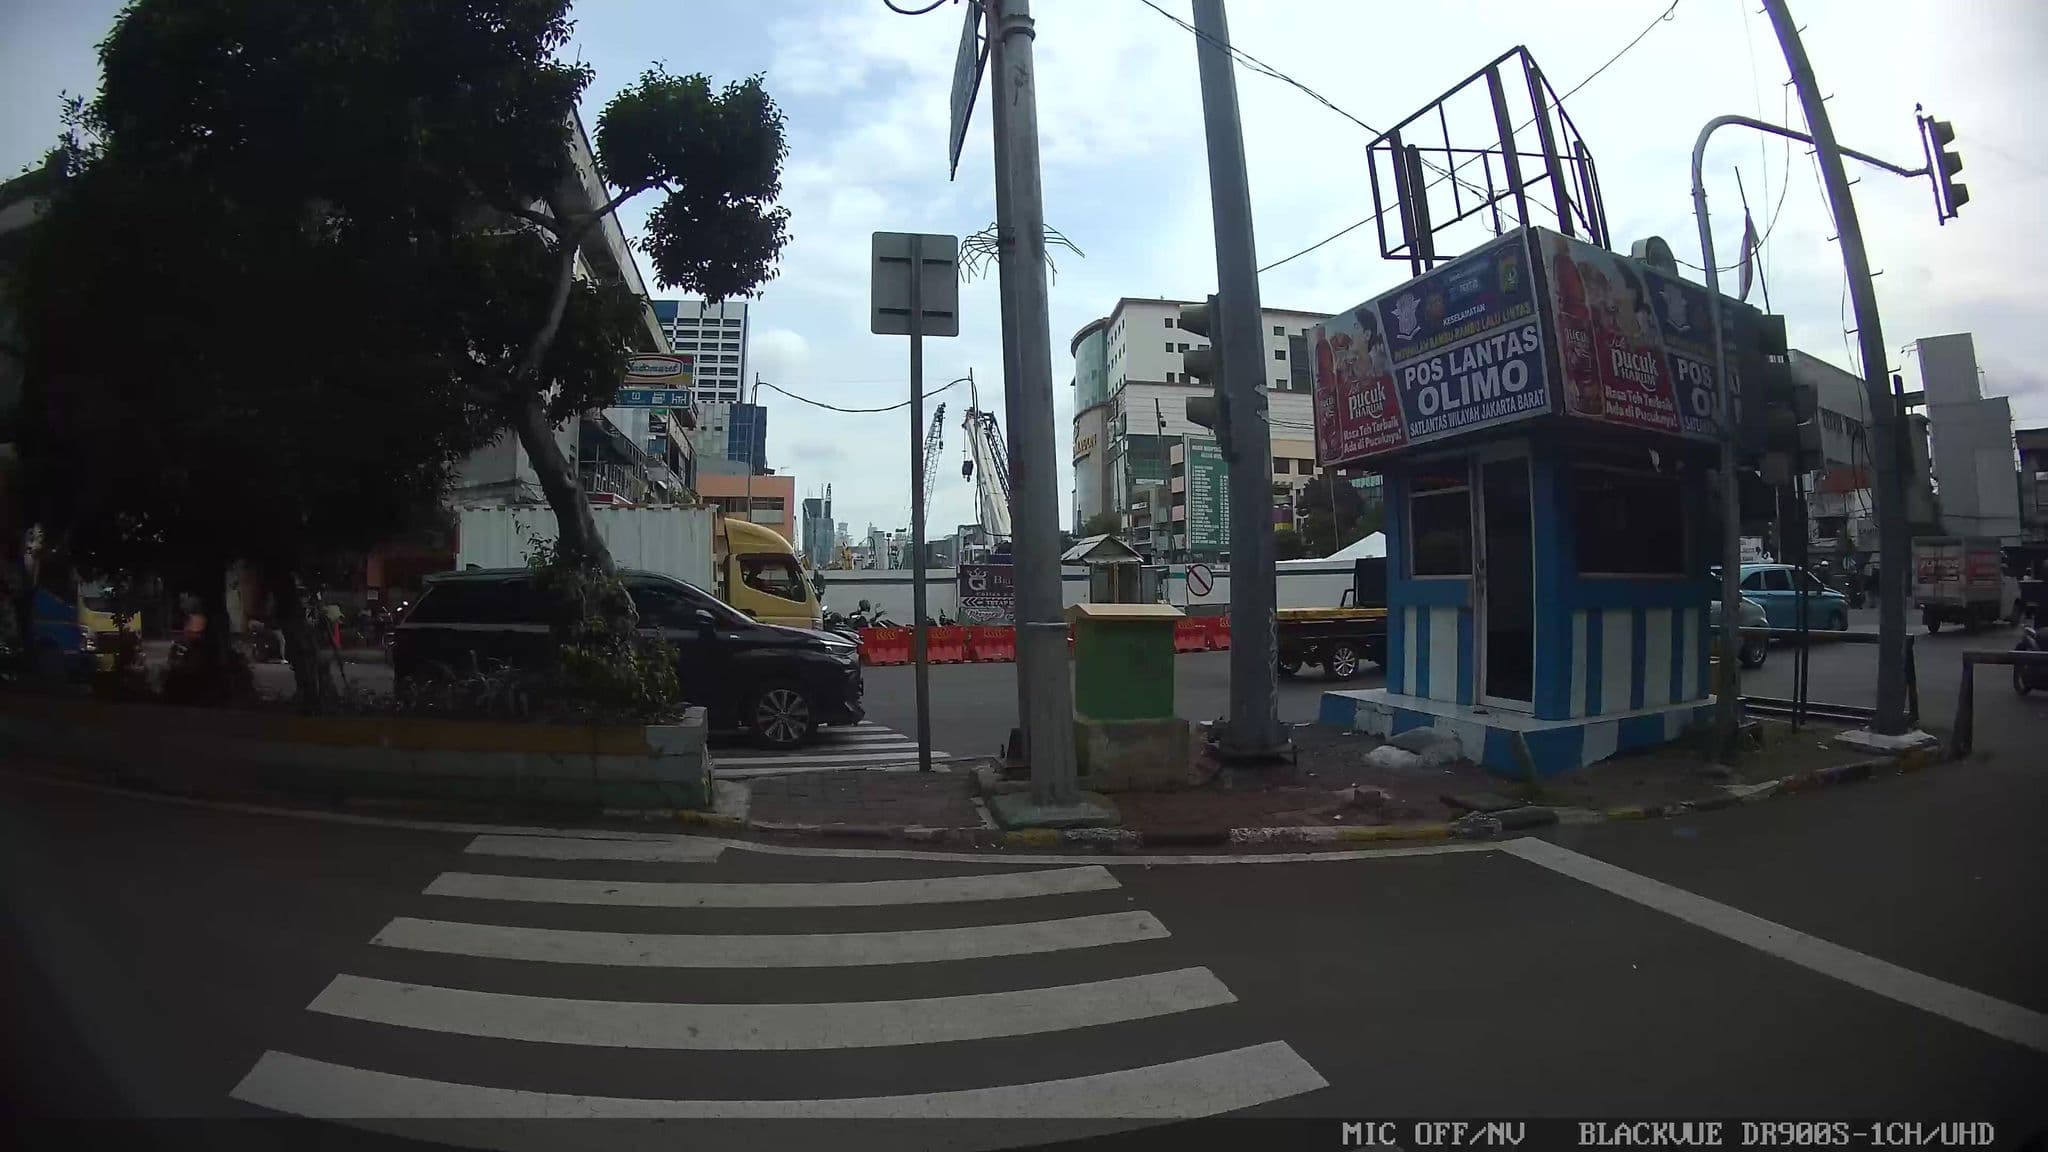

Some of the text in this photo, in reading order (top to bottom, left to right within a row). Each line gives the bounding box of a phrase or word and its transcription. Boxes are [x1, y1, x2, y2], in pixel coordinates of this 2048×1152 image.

[1442, 303, 1487, 327] KESELAMATAN
[1405, 326, 1538, 390] POS LANTAS
[1418, 360, 1528, 416] OLIMO
[1677, 358, 1712, 390] POS
[1349, 381, 1387, 419] pucuk
[1605, 385, 1673, 411] Rasa Teh Terbaik
[1606, 401, 1625, 416] Ada
[1625, 404, 1634, 417] di
[1410, 388, 1545, 438] SATLANTAS WILAYAH JAKARTA BARAT
[1344, 415, 1399, 441] Rasa Teh Terbaik
[1344, 442, 1358, 453] Ada
[1358, 437, 1365, 451] di
